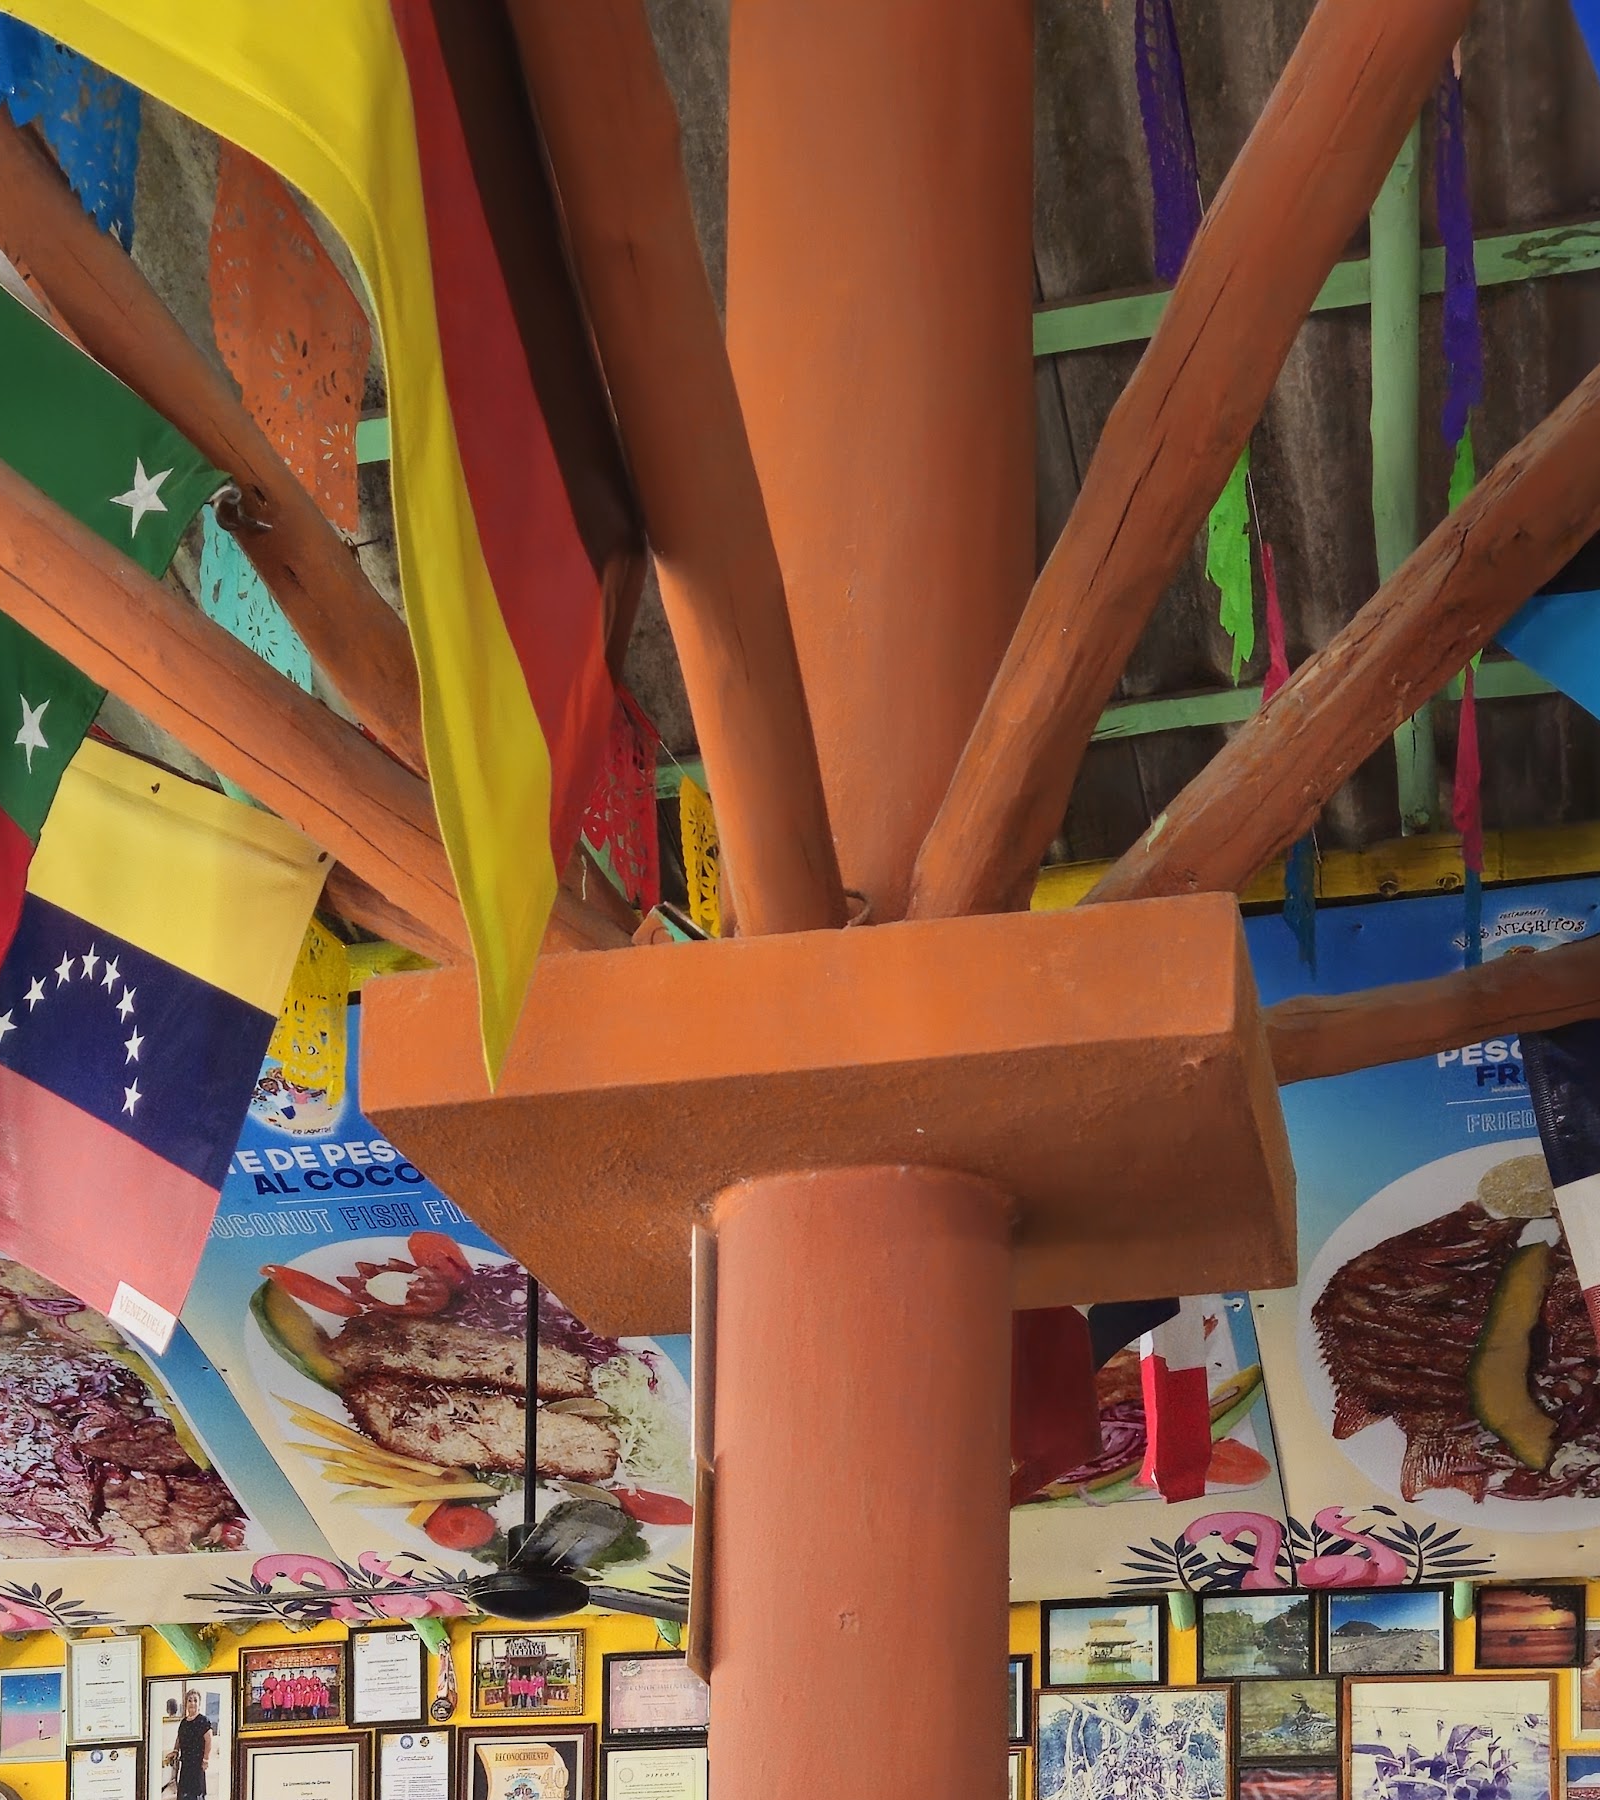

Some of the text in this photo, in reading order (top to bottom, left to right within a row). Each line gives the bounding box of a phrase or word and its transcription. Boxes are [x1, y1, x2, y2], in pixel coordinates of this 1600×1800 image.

[1495, 917, 1586, 937] NEGRITOS
[1476, 1062, 1527, 1087] FR
[1466, 1109, 1537, 1133] FRIED
[271, 1147, 314, 1171] DE
[254, 1163, 426, 1195] AL COCO
[206, 1208, 334, 1240] OCONUT
[338, 1202, 420, 1231] FISH
[119, 1295, 167, 1339] VENEZUELA
[541, 1767, 569, 1790] 40
